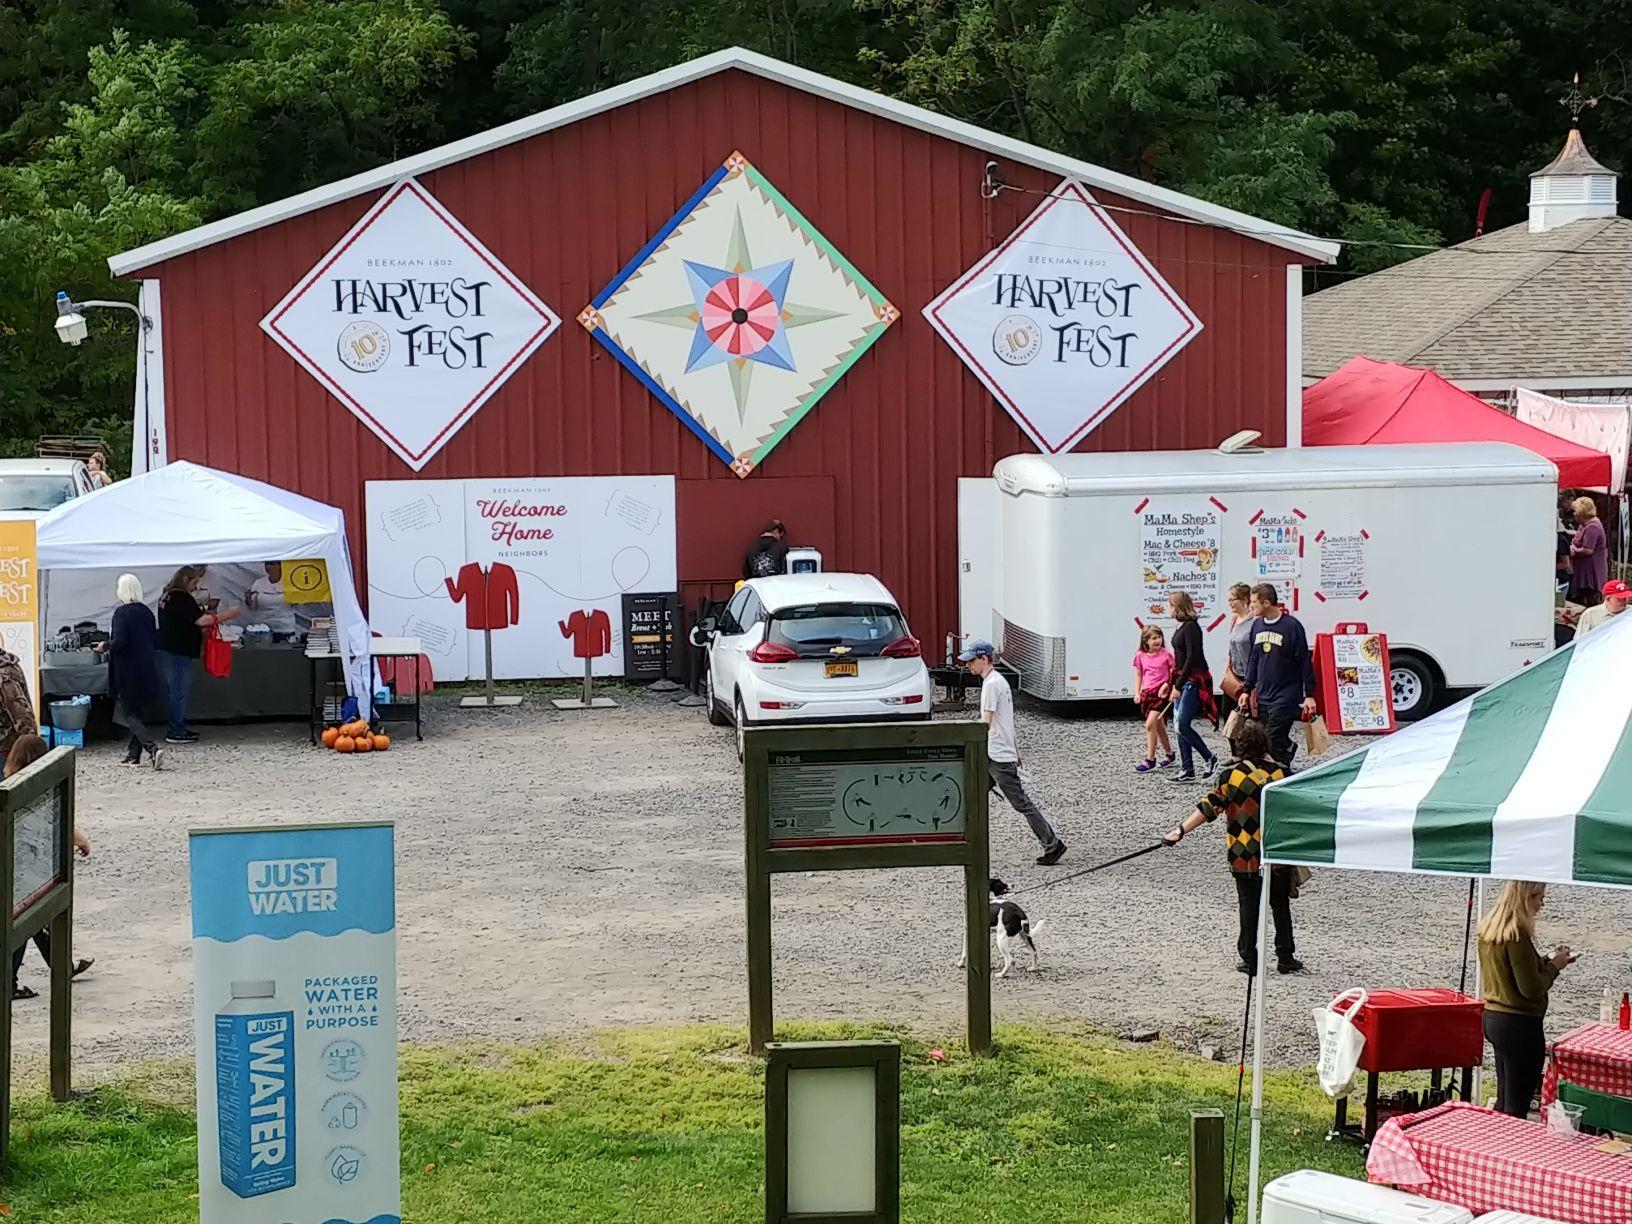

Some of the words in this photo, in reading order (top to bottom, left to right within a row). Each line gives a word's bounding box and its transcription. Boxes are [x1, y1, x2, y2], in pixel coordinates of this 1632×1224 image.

[367, 258, 424, 267] BEEKMAN
[1028, 255, 1080, 265] BEEKMAN
[330, 277, 493, 320] HARVEST
[992, 274, 1142, 318] HARVEST
[396, 324, 494, 370] FEST
[1049, 321, 1139, 368] FEST
[476, 499, 568, 518] Welcome
[492, 520, 554, 547] Home
[1156, 526, 1205, 538] Homestyle
[1144, 540, 1162, 549] Mac
[1164, 539, 1172, 548] &
[1172, 538, 1206, 549] Cheese
[1172, 571, 1208, 582] Nachos
[254, 862, 326, 888] JUST
[248, 890, 338, 916] WATER
[304, 976, 378, 988] PACKAGED
[305, 987, 378, 1004] WATER
[318, 1004, 352, 1015] WITH
[357, 1004, 366, 1013] A
[252, 1020, 283, 1032] JUST
[306, 1016, 378, 1030] PURPOSE
[250, 1033, 287, 1170] WATER
